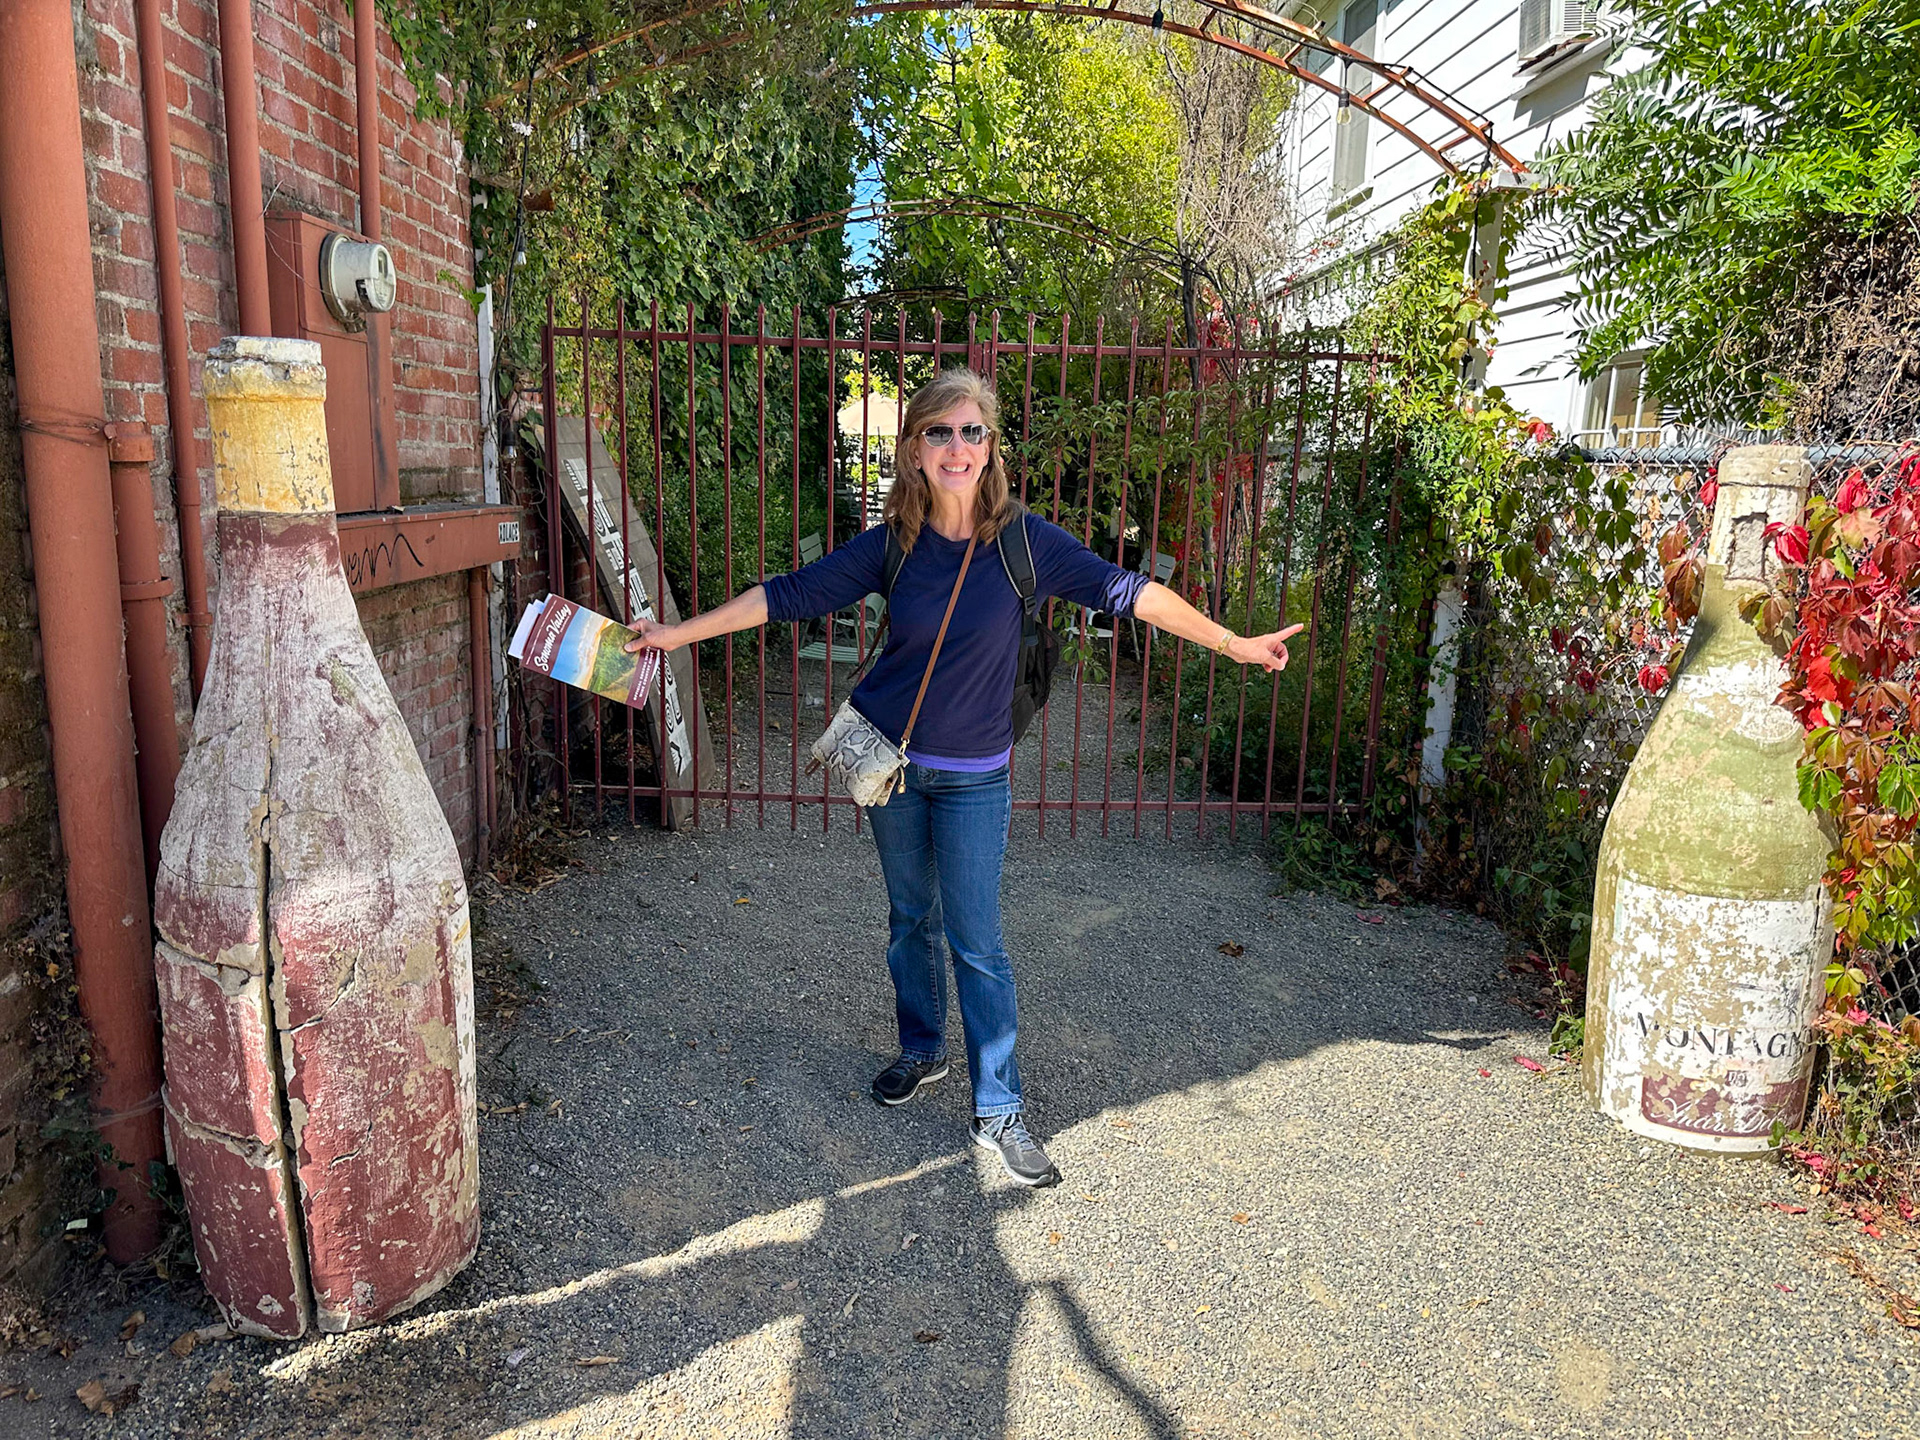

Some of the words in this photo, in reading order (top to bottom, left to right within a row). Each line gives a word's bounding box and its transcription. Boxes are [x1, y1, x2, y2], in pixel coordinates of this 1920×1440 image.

[534, 631, 557, 671] Sonoma
[546, 604, 571, 634] Valley
[633, 681, 642, 700] OFFICIAL
